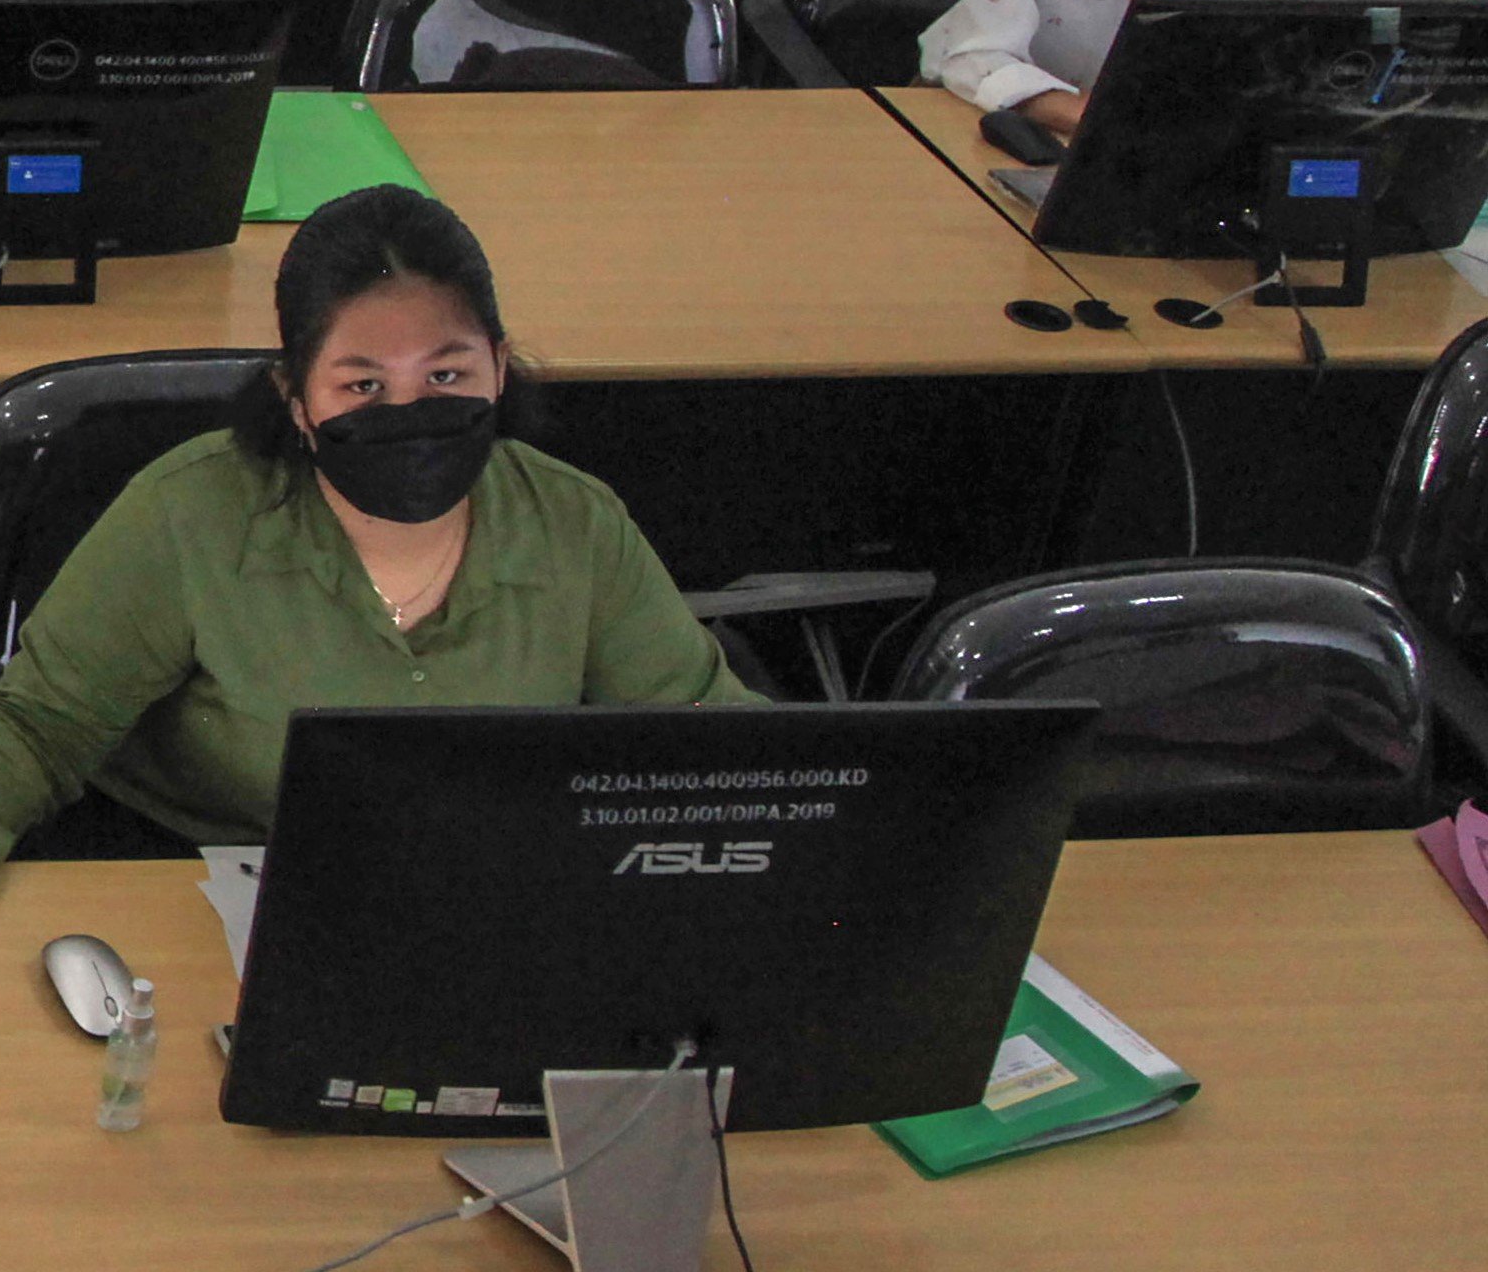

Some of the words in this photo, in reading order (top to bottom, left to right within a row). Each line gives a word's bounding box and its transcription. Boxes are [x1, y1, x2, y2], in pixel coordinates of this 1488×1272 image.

[570, 768, 868, 793] 042.04.1400.400956.000.KD
[580, 802, 836, 827] 3.10.01.02.001/DIPA.2019
[612, 840, 773, 875] ASUS
